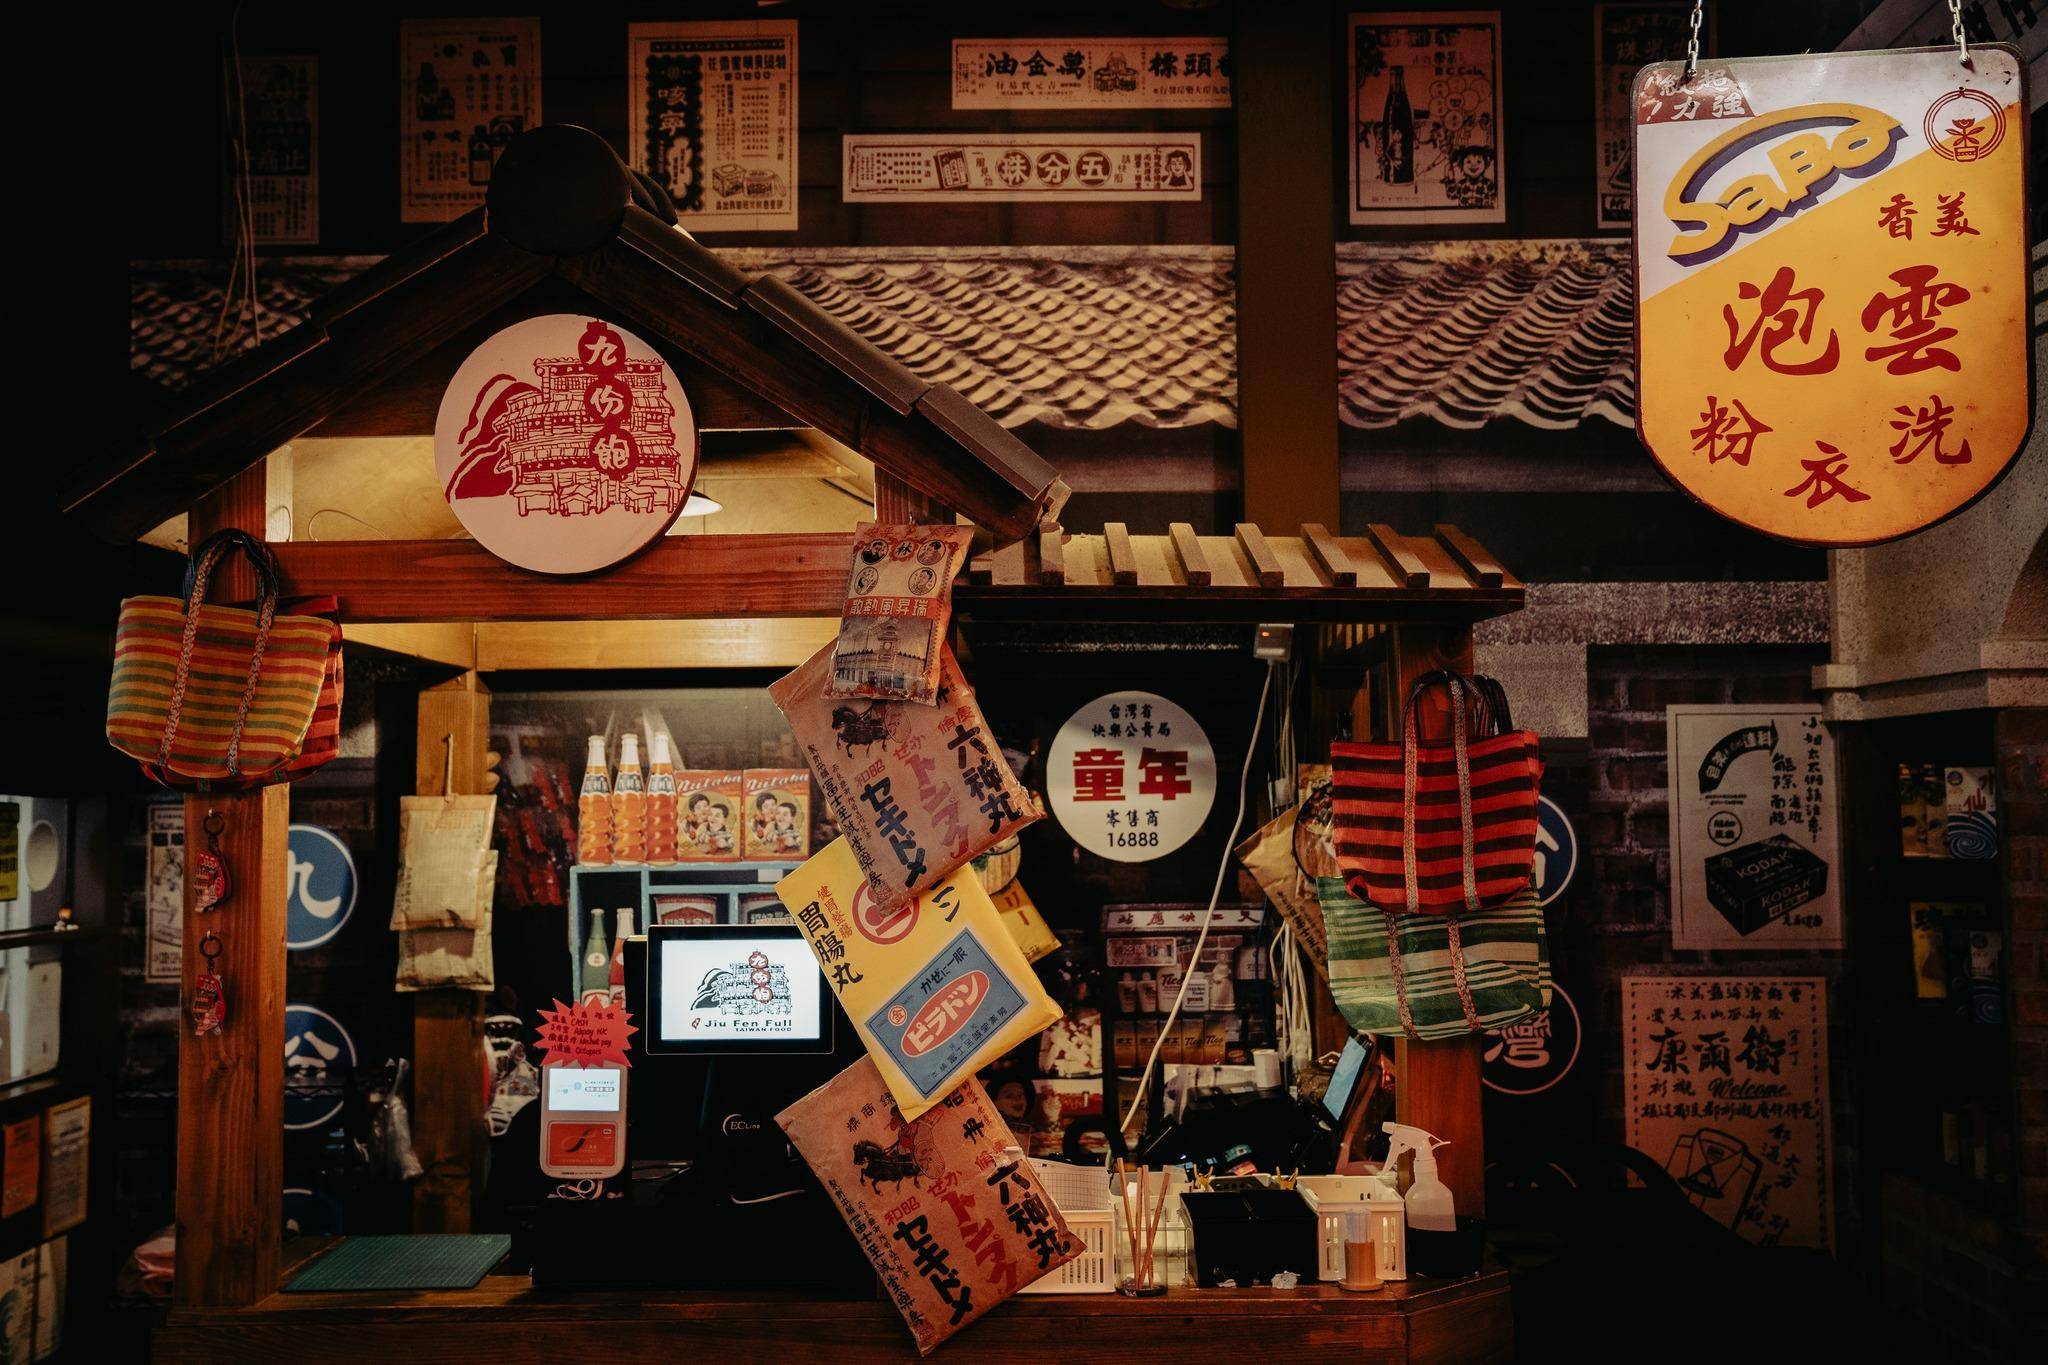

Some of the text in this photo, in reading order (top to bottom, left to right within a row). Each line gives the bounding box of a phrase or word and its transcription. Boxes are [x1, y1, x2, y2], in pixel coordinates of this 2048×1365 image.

[1073, 747, 1191, 801] 童年
[1106, 809, 1159, 827] 零售商
[1107, 832, 1159, 847] 16888
[907, 975, 980, 1052] ピラドン
[705, 1019, 792, 1028] Jiu Fen Full
[1709, 1078, 1790, 1098] Welcome
